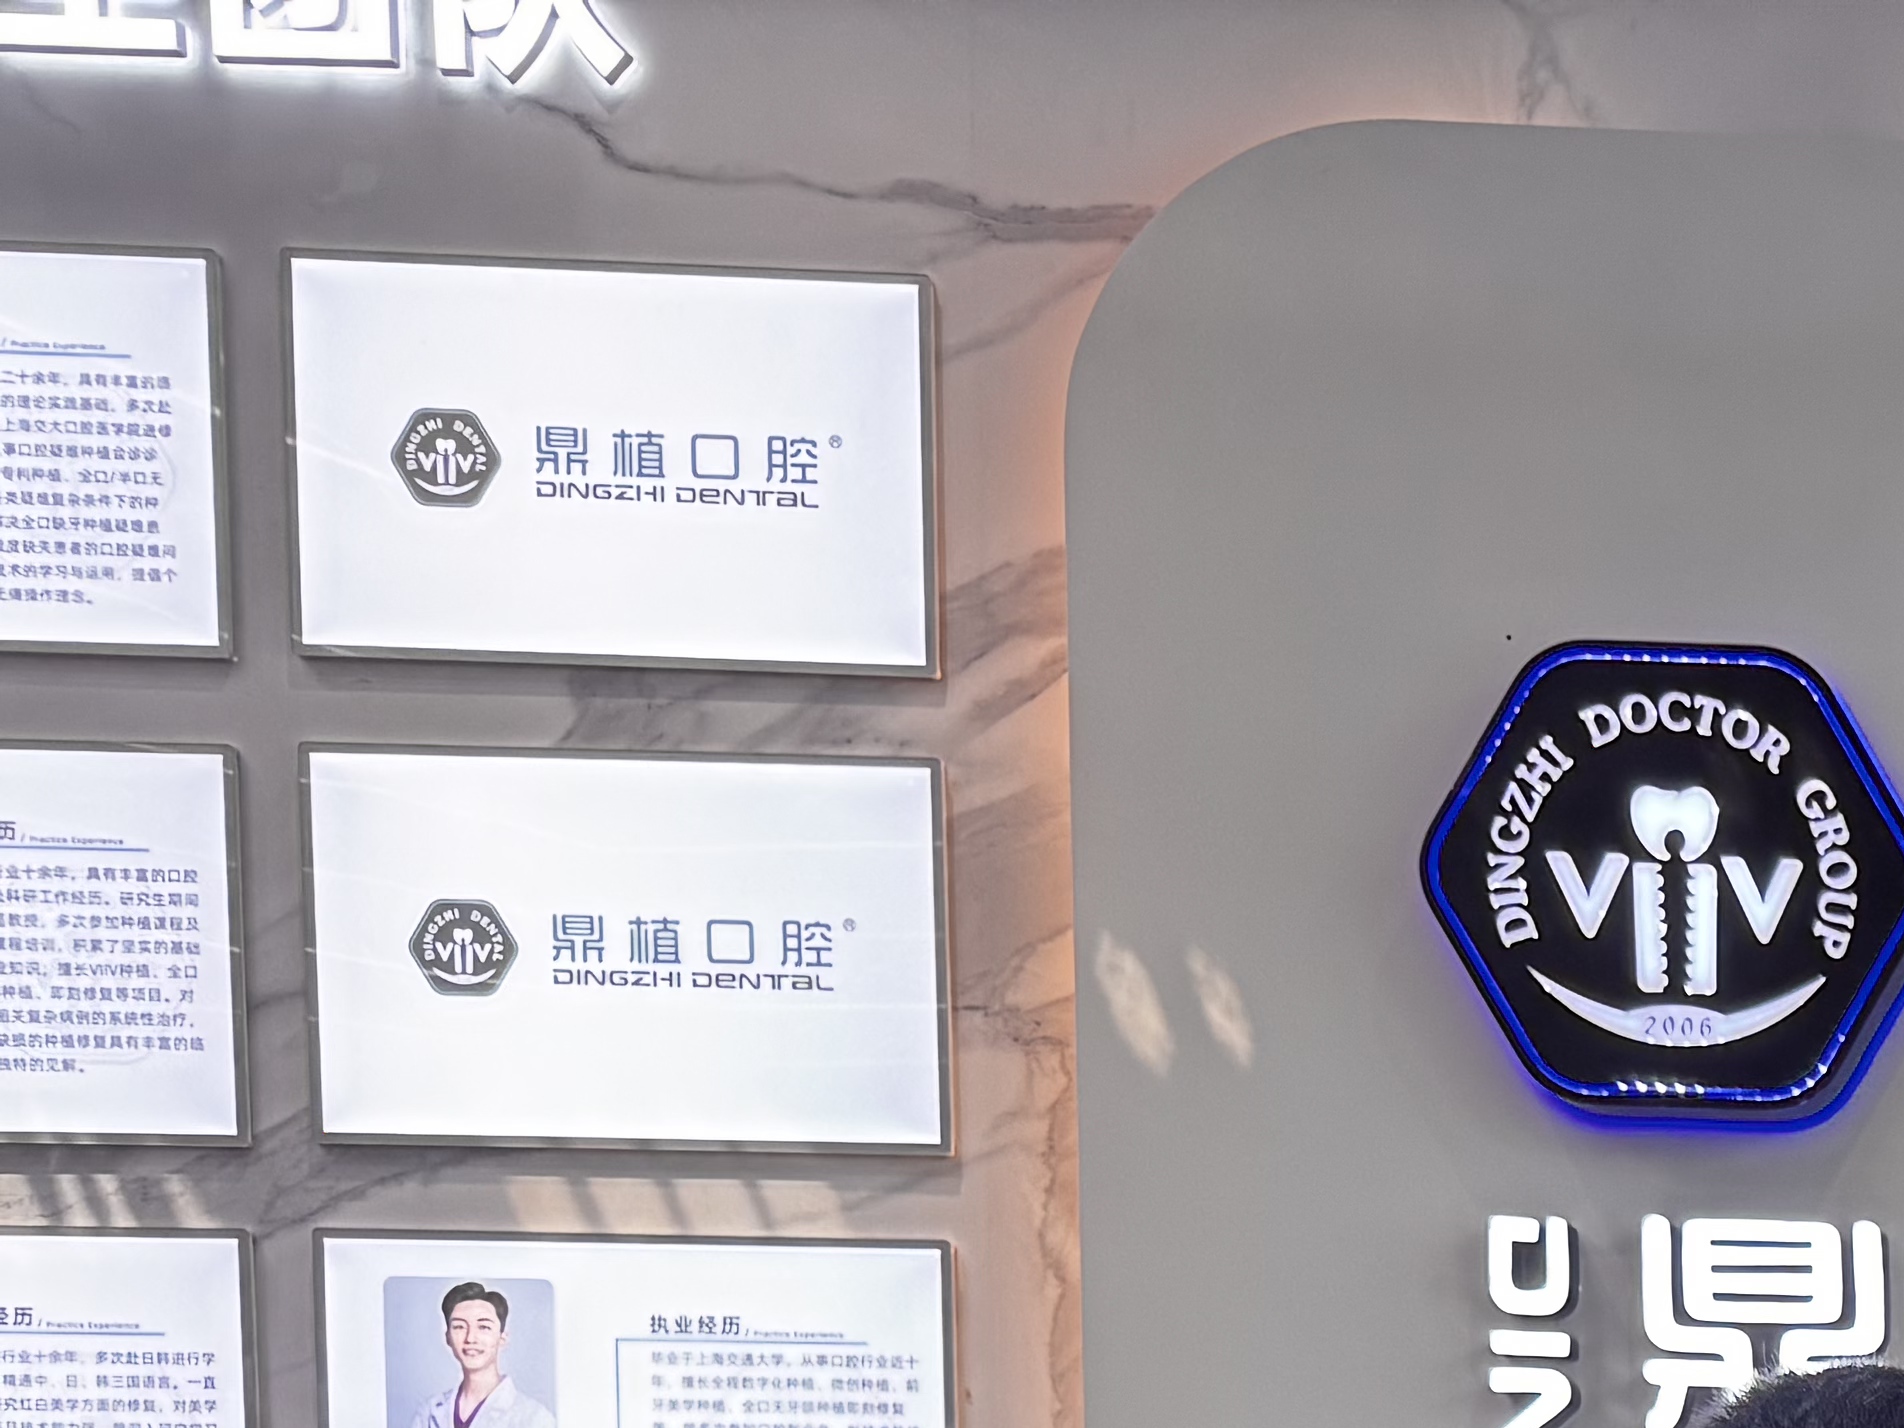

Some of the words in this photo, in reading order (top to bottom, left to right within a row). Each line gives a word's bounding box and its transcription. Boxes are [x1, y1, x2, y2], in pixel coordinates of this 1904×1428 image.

[535, 425, 819, 484] 鼎植口腔
[536, 481, 665, 504] DINGZHI
[1486, 734, 1575, 948] DINGZHI
[1577, 690, 1791, 776] DOCTOR
[1795, 778, 1859, 961] GROUP
[552, 913, 834, 968] 鼎植口腔
[553, 968, 682, 988] DINGZHI
[1643, 1014, 1713, 1039] 2006
[650, 1315, 741, 1336] 执业经历
